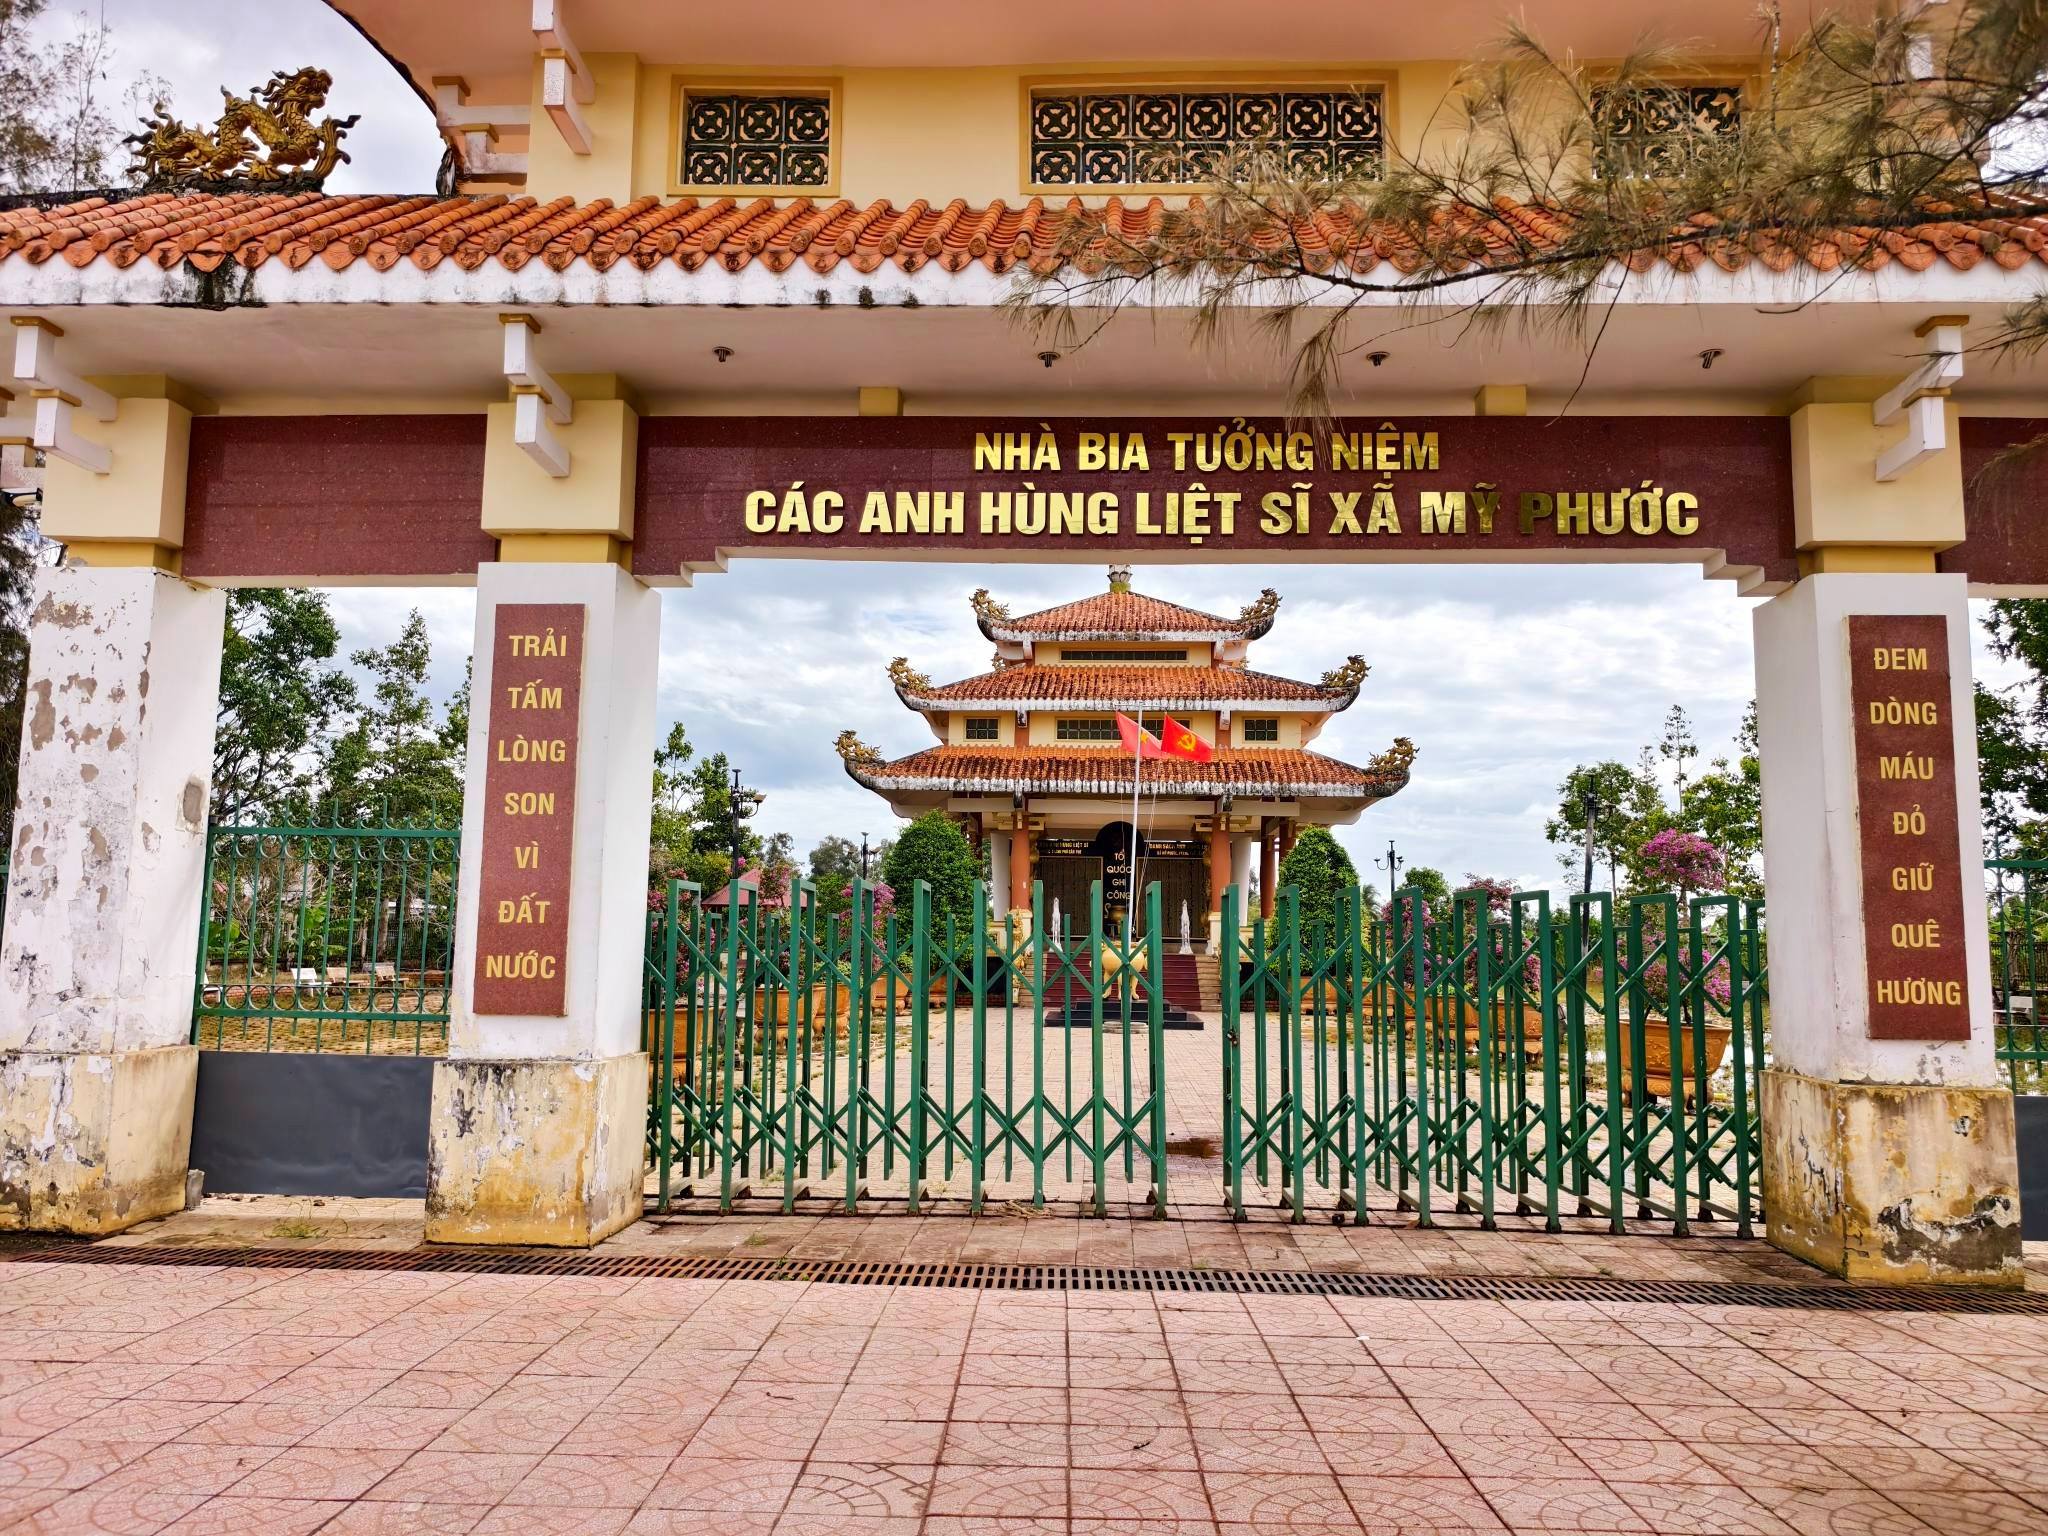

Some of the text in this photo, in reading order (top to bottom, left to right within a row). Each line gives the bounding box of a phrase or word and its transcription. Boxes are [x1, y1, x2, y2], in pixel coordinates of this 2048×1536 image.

[974, 417, 1440, 479] NHÀ BIA TƯỞNG NIỆM
[744, 479, 1700, 544] CÁC ANH HÙNG LIỆT SĨ XÃ MỸ PHƯỚC
[509, 628, 567, 657] TRẢI
[1873, 647, 1928, 671] ĐEM
[508, 679, 562, 709] TẤM
[1869, 697, 1938, 726] DÒNG
[498, 735, 566, 763] LÒNG
[1879, 751, 1934, 780] MÁU
[504, 792, 555, 816] SON
[1892, 804, 1926, 836] ĐỎ
[515, 841, 539, 869] VÌ
[1892, 862, 1935, 891] GIỮ
[498, 892, 551, 924] ĐẤT
[1106, 889, 1131, 900] CÔNG
[1891, 919, 1941, 949] QUÊ
[486, 951, 556, 980] NƯỚC
[1877, 979, 1961, 1006] HƯƠNG
